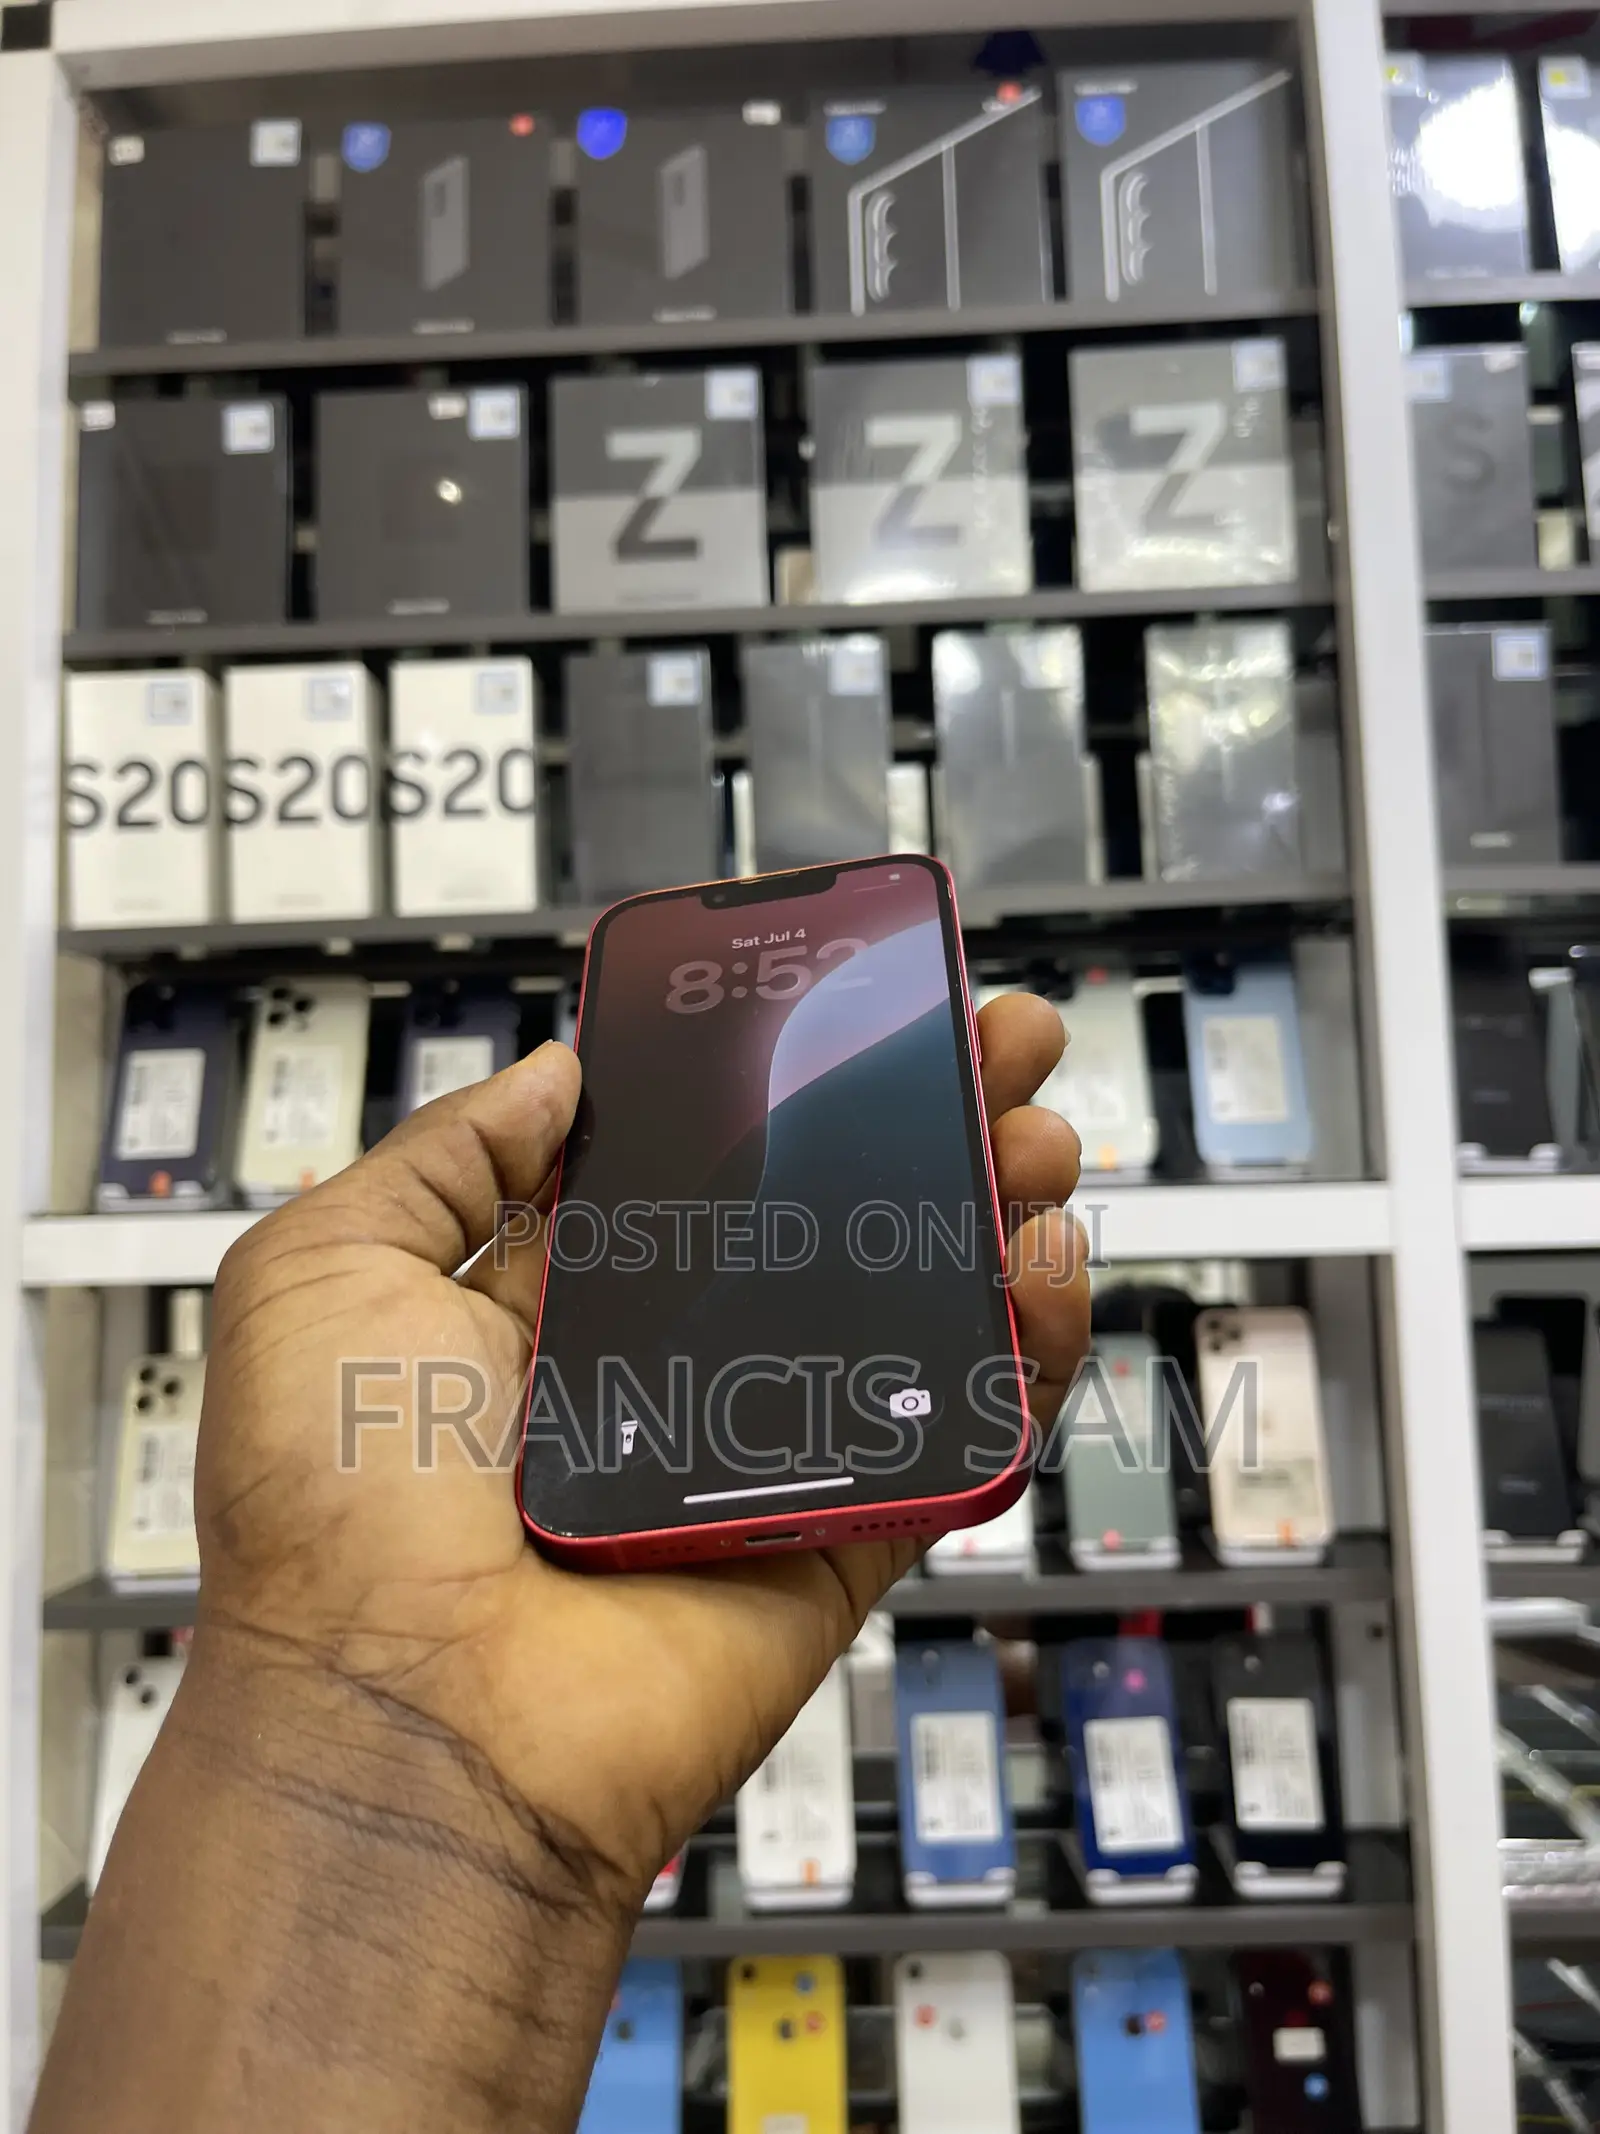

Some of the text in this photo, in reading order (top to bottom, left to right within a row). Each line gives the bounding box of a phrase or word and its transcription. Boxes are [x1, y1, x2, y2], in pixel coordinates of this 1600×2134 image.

[606, 430, 702, 562] Z
[866, 414, 961, 550] Z
[1128, 401, 1226, 535] Z
[664, 937, 874, 1014] 8:52
[731, 928, 807, 950] Sat Jul 4
